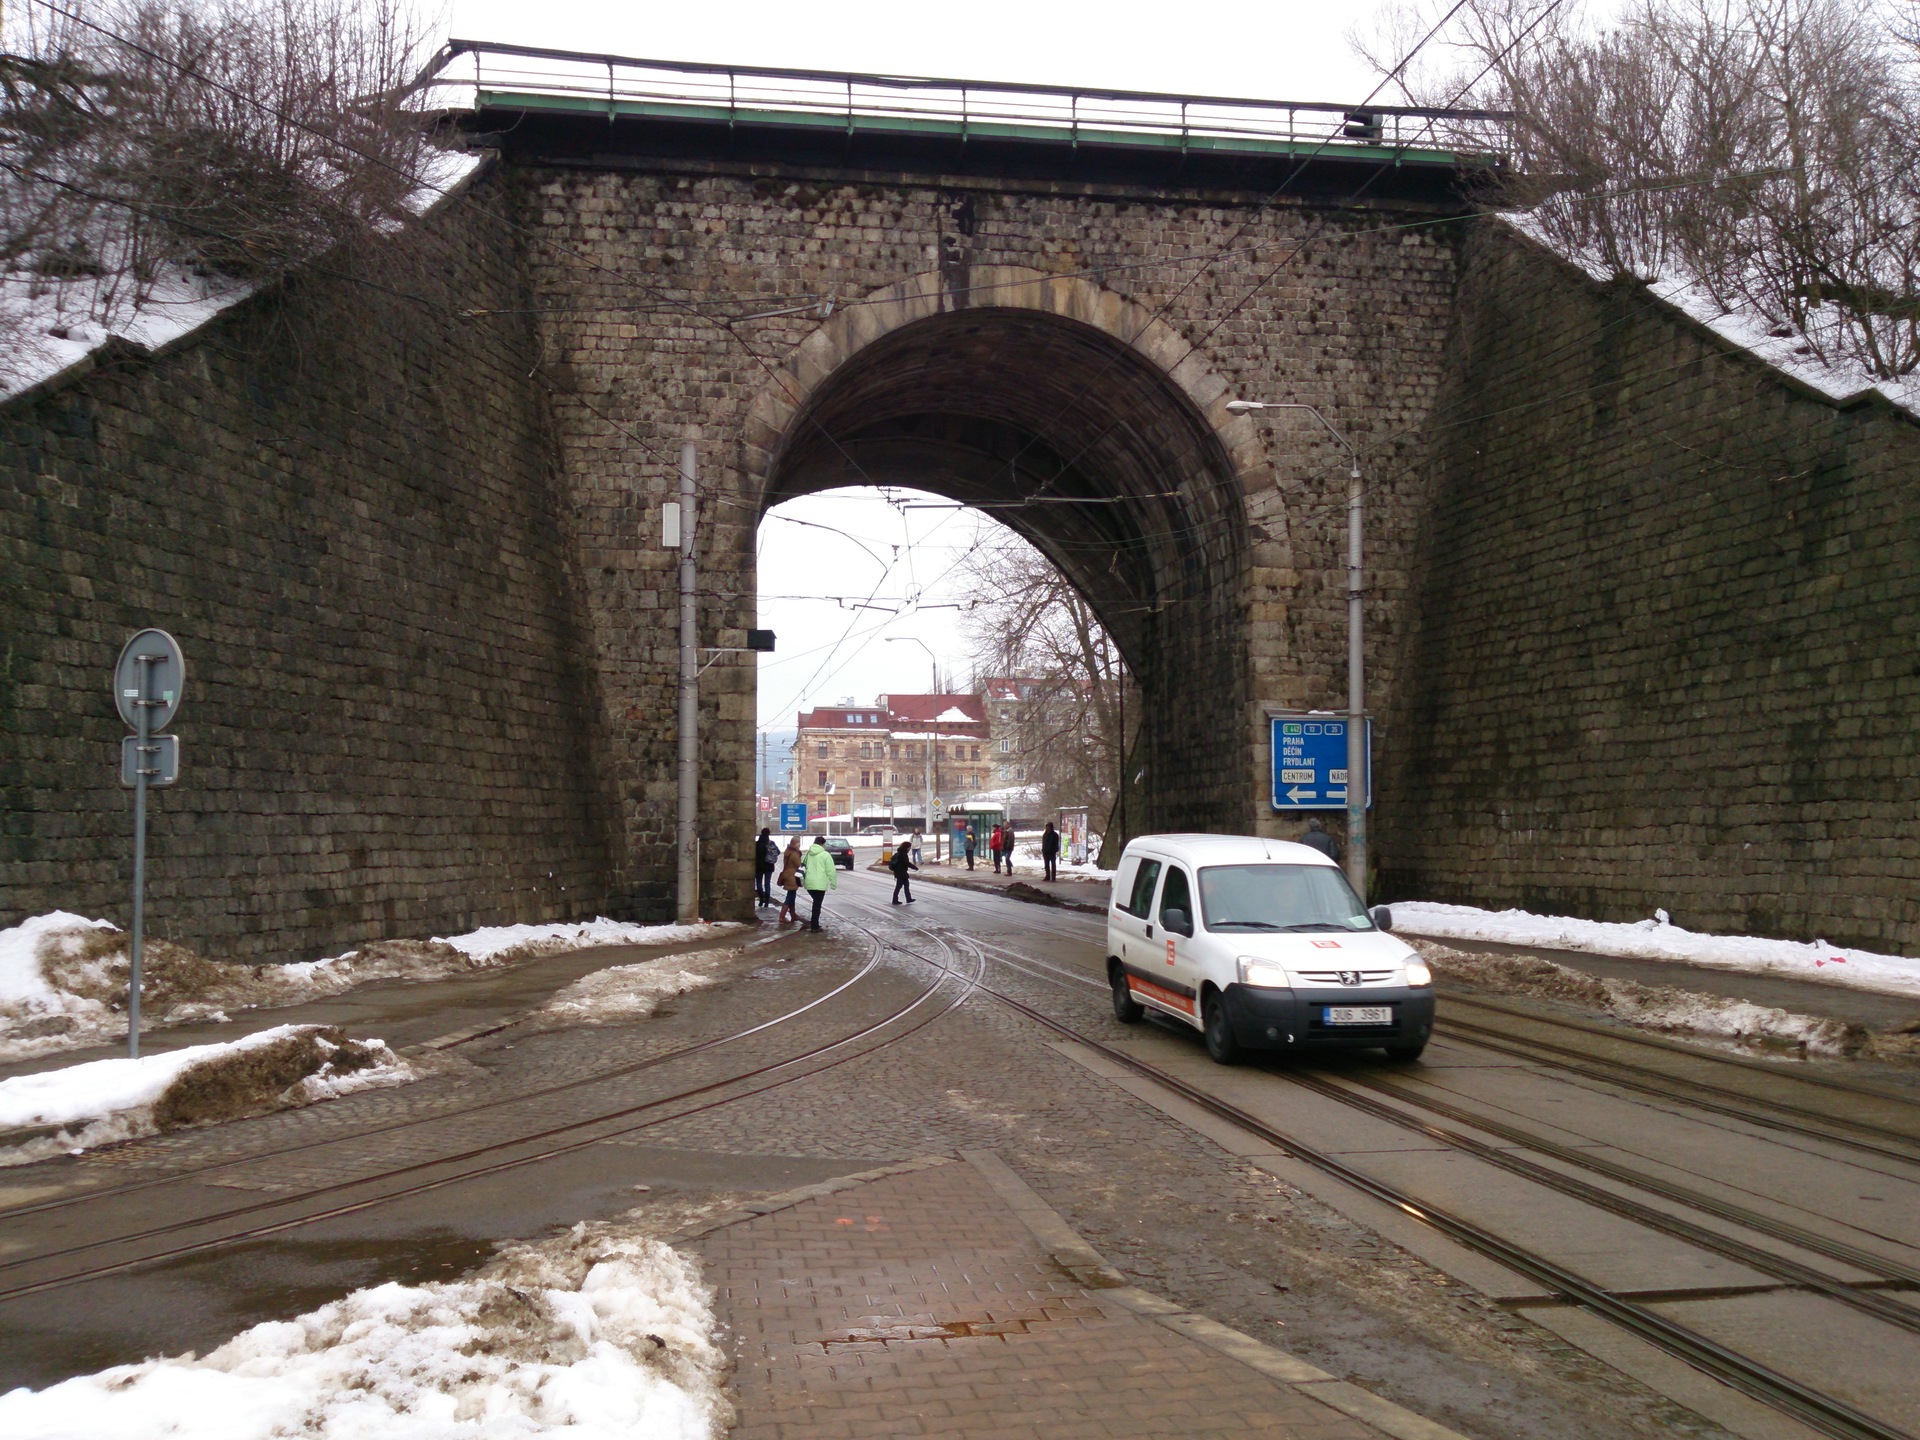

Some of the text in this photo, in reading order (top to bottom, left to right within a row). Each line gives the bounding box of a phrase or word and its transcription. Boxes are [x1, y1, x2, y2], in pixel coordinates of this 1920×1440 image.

[1283, 737, 1304, 745] PRAHA
[1283, 746, 1302, 755] DĚČÍN
[1283, 757, 1315, 766] FRÝDLANT
[1283, 772, 1313, 780] CENTRUM
[1331, 771, 1348, 780] NÁDR
